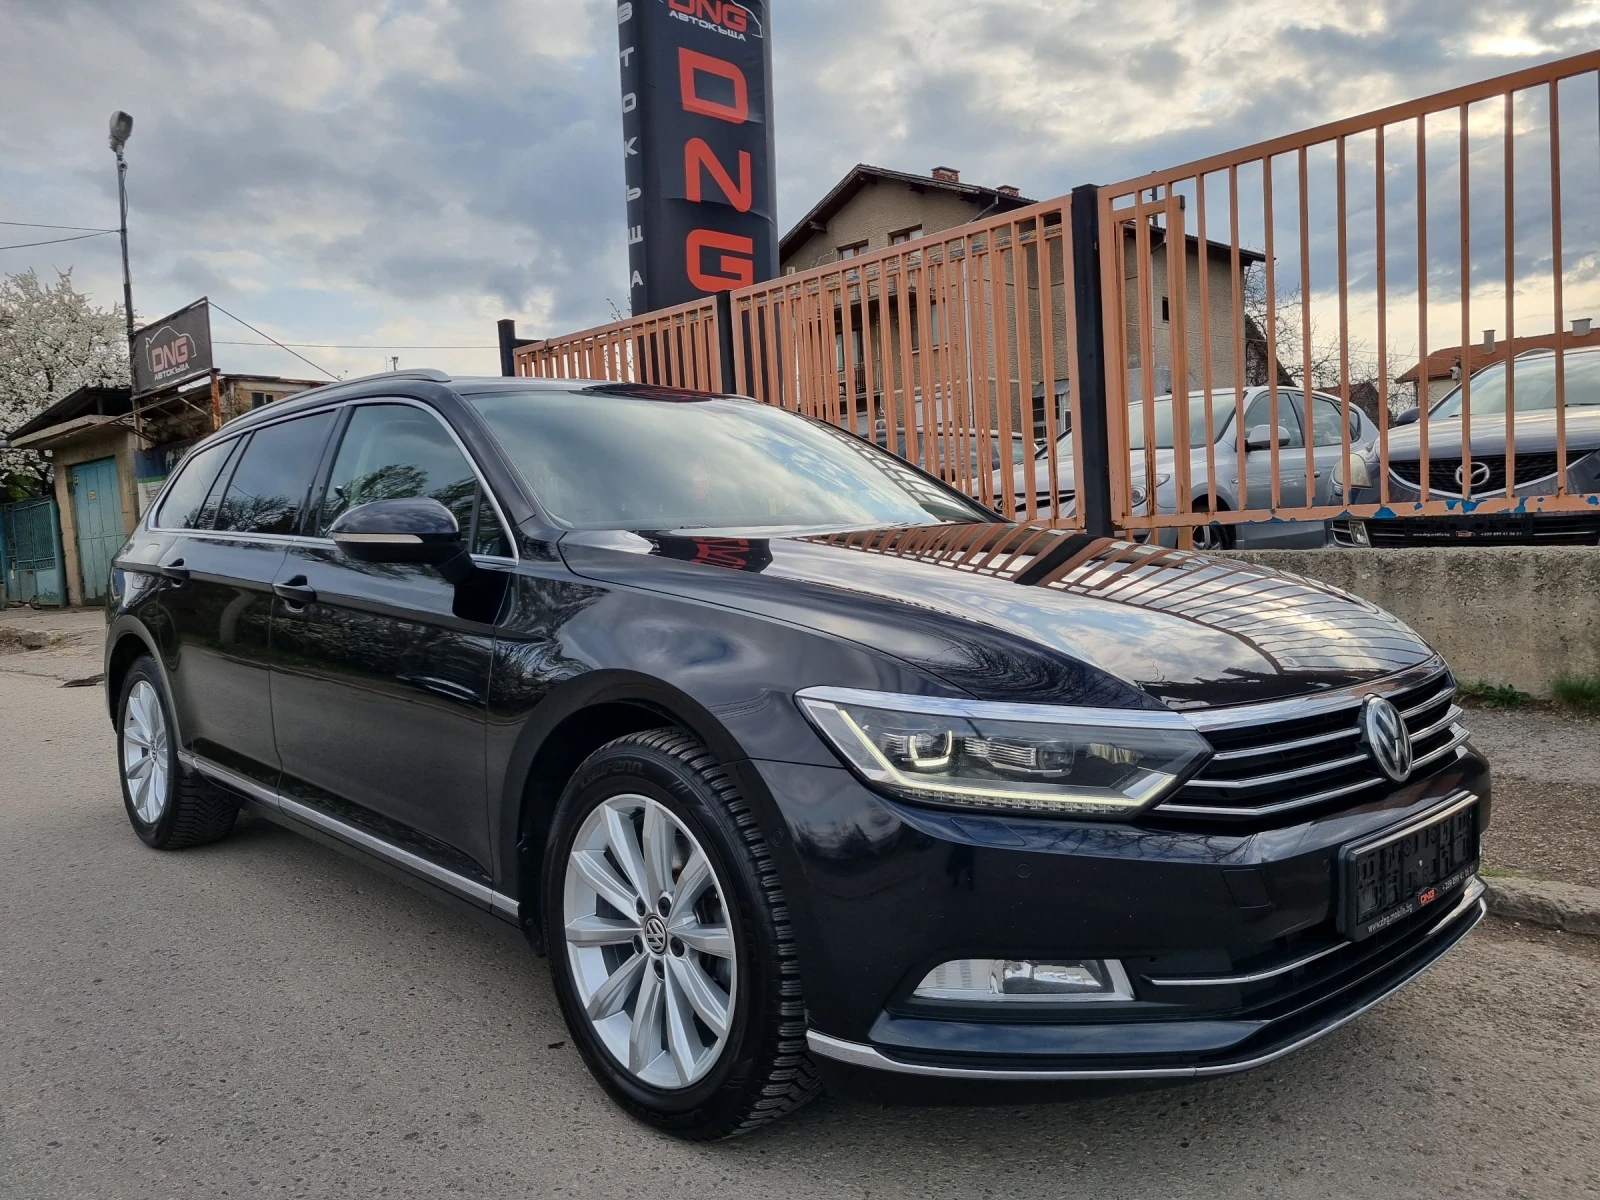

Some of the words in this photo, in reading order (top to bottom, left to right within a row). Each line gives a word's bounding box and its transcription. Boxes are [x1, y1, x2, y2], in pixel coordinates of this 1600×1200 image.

[668, 0, 747, 33] DNG
[151, 336, 189, 373] DNG
[1367, 902, 1413, 933] www.dng.mobile.bg
